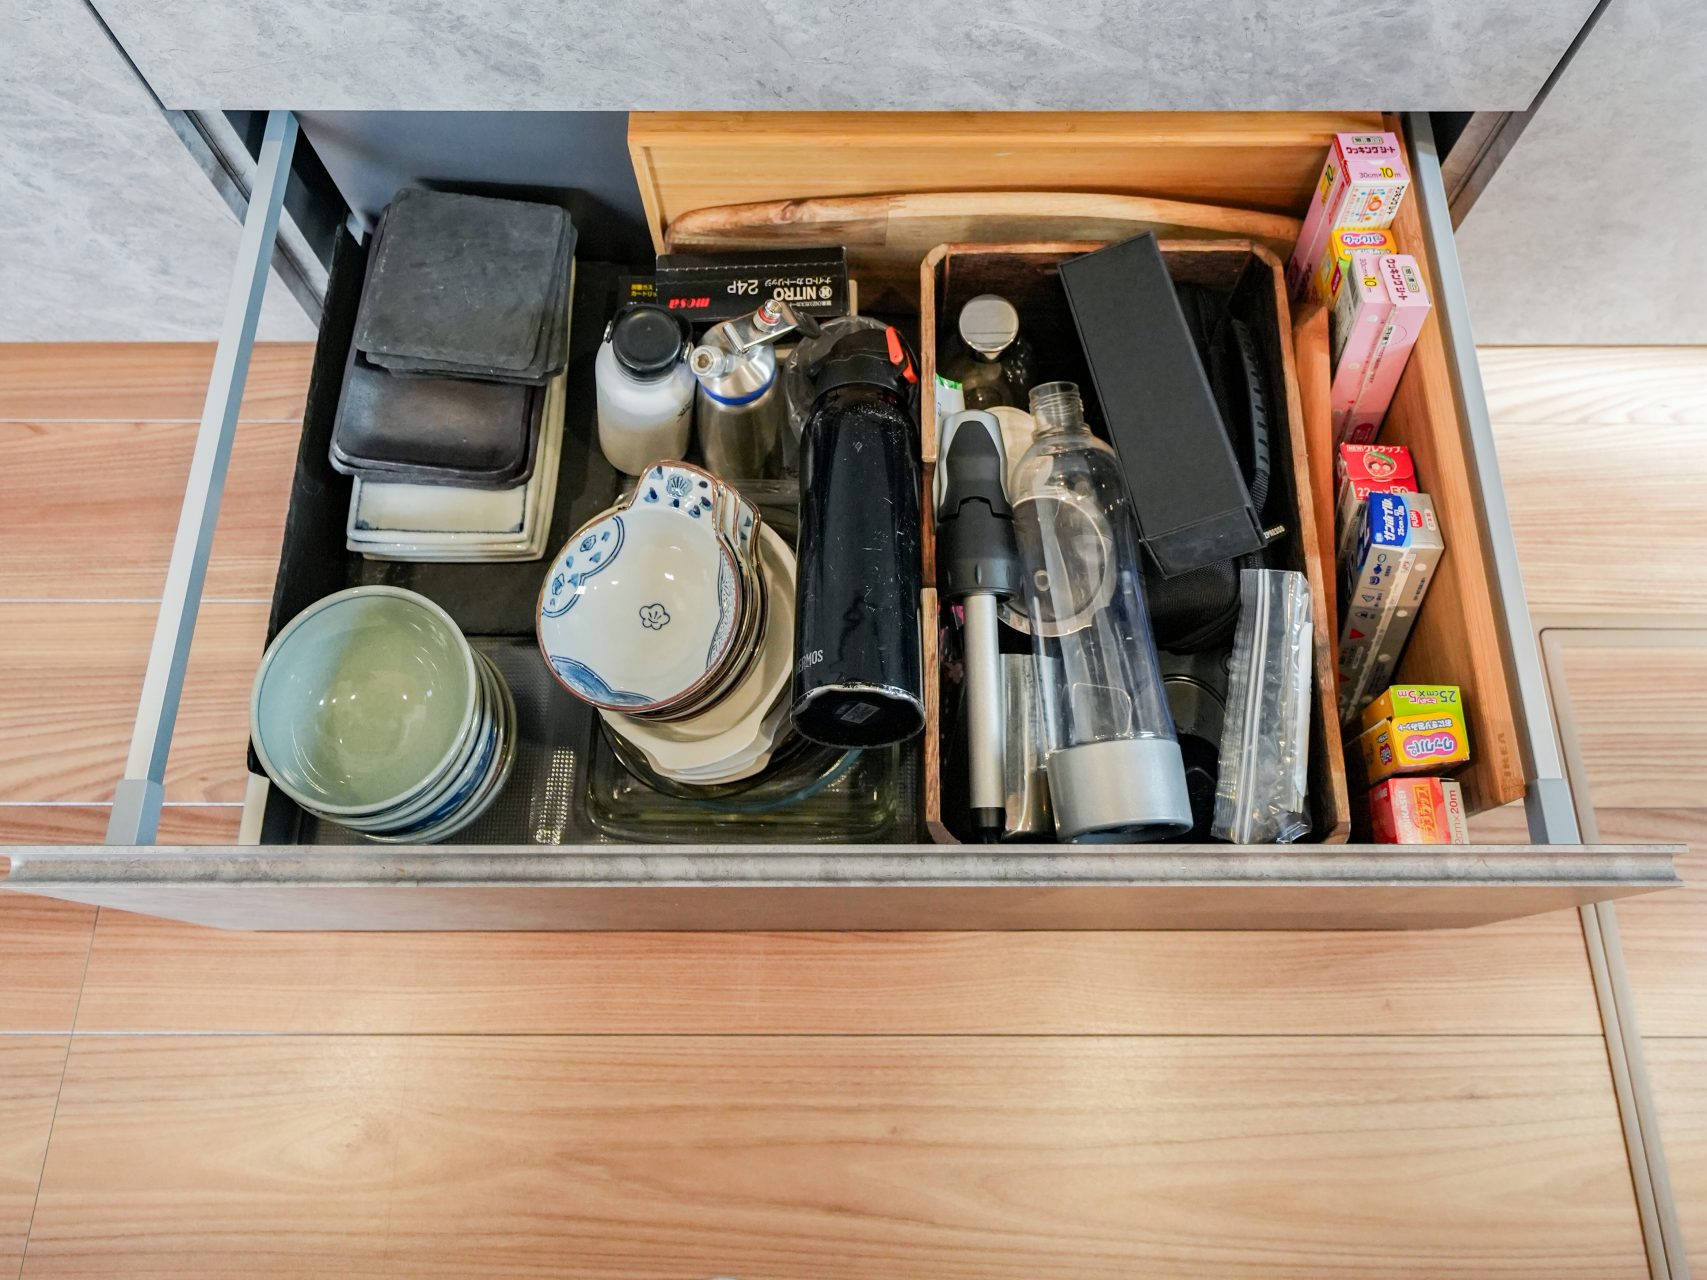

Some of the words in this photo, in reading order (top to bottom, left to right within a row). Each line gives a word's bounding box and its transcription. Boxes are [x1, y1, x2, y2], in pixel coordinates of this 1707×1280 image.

[1346, 146, 1396, 154] クッキングシート
[727, 279, 759, 295] 24P
[764, 277, 803, 287] カートリッジ
[805, 276, 832, 286] ナイトロ
[1386, 258, 1408, 301] クッキングシート
[773, 286, 817, 301] NITRO
[1382, 498, 1395, 541] サンホイル
[1410, 511, 1420, 527] PUSH
